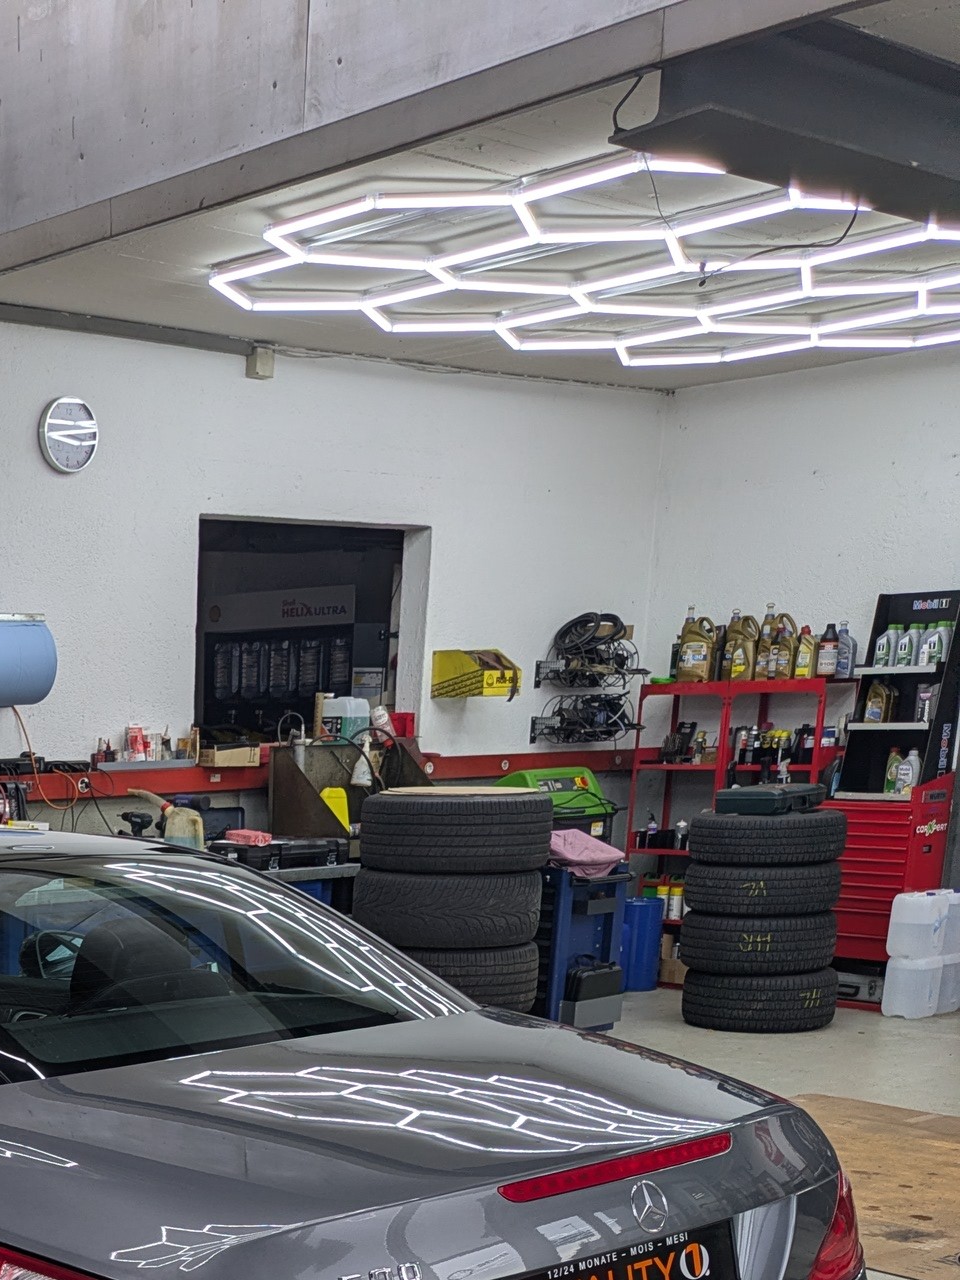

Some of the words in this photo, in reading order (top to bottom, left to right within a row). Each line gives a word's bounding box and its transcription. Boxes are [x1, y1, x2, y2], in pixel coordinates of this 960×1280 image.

[281, 606, 313, 618] HELIX
[314, 605, 347, 616] ULTRA
[912, 599, 939, 610] Mobil
[938, 723, 952, 769] Mobil
[547, 1264, 575, 1280] 12/24
[579, 1251, 618, 1271] MONATE
[630, 1241, 654, 1257] MOIS
[666, 1231, 689, 1246] MESI
